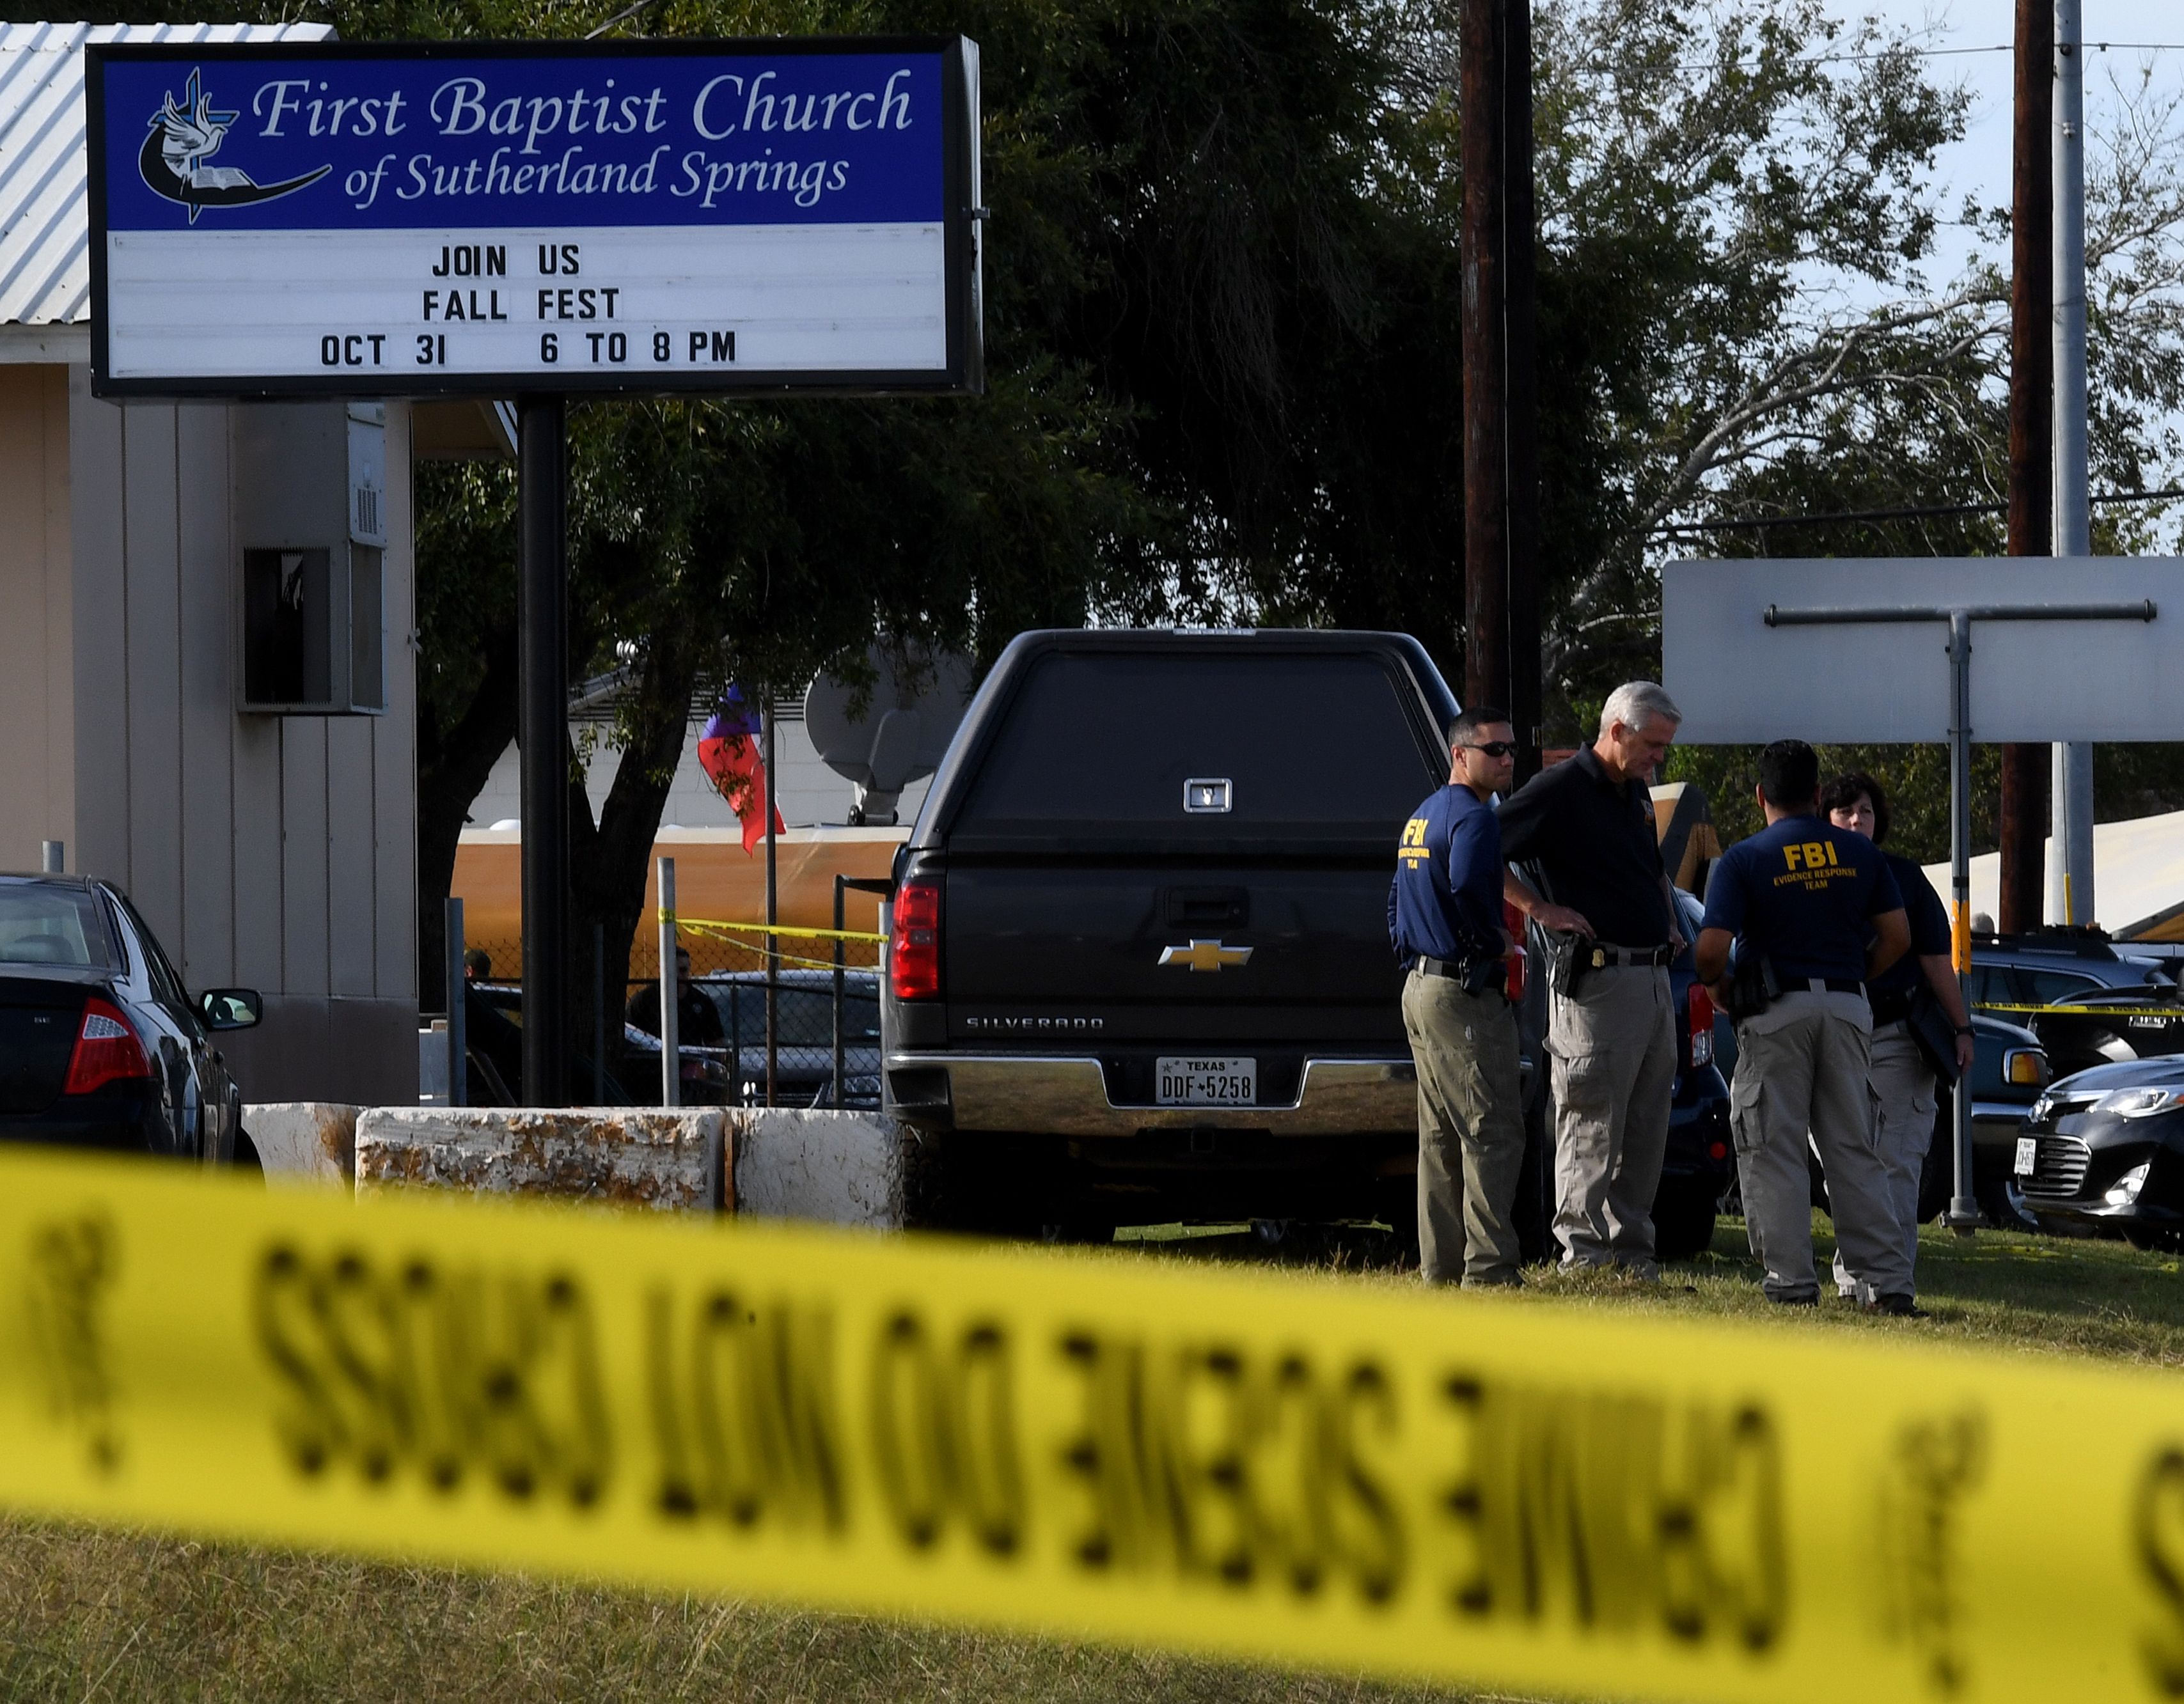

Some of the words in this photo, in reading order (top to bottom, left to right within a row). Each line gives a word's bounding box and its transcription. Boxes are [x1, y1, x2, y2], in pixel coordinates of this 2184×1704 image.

[253, 79, 407, 137] First
[430, 77, 668, 155] Baptist
[693, 69, 913, 140] Church
[345, 153, 397, 210] of
[396, 145, 671, 200] Sutherland
[670, 148, 849, 208] Springs
[432, 245, 506, 277] JOIN
[538, 244, 579, 275] US
[423, 290, 507, 321] FALL
[538, 288, 619, 319] FEST
[321, 334, 386, 366] OCT
[416, 334, 445, 364] 31
[540, 332, 558, 363] 6
[585, 332, 626, 363] TO
[653, 332, 670, 362] 8
[689, 331, 735, 362] PM
[1403, 819, 1429, 845] FBI
[1782, 841, 1838, 870] FBI
[1773, 872, 1813, 886] EVIDENCE
[1814, 868, 1857, 879] RESPONSE
[1804, 879, 1828, 890] TEAM
[966, 1017, 1103, 1028] SILVERADO
[1186, 1061, 1226, 1072] TEXAS
[251, 1234, 613, 1517] CROSS
[645, 1285, 849, 1544] NOT
[865, 1302, 1028, 1562] DO
[1055, 1324, 1411, 1611] SCENE
[1438, 1359, 1789, 1664] CRIME
